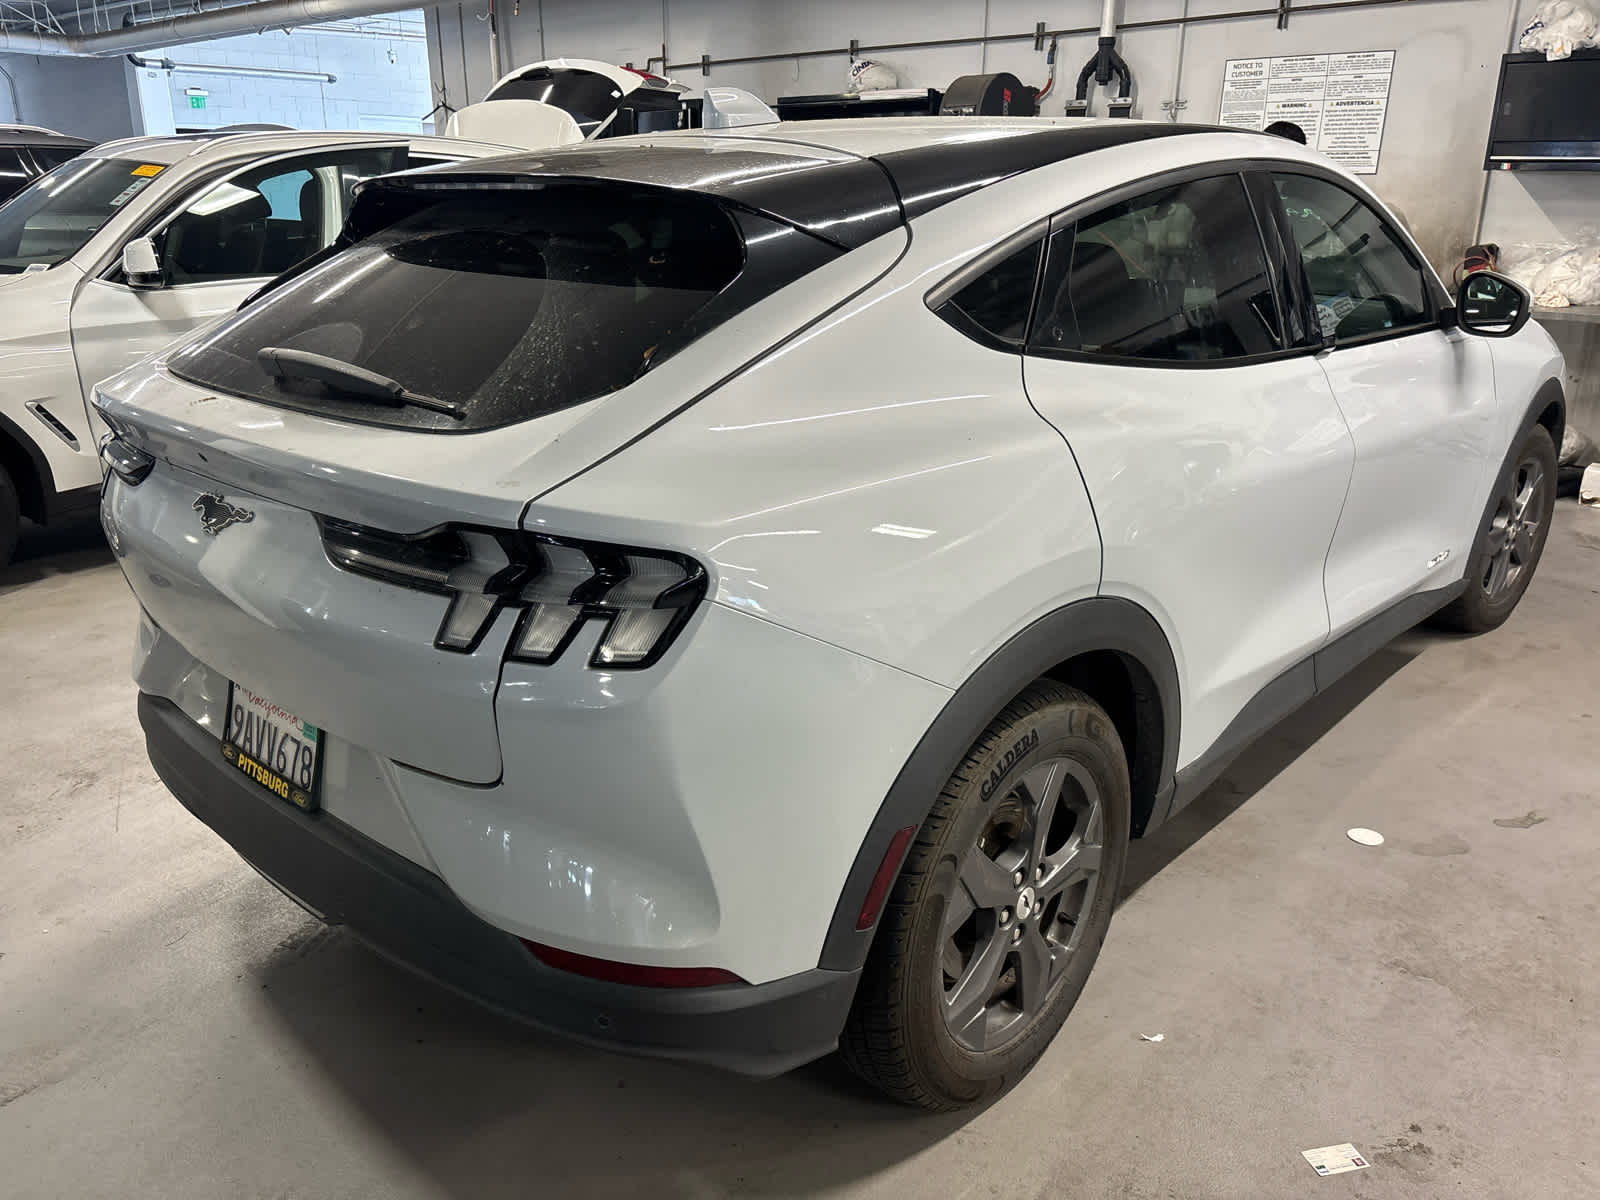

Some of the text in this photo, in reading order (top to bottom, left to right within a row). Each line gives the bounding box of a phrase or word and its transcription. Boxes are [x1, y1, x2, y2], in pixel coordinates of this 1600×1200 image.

[1231, 70, 1263, 78] CUSTOMER
[237, 753, 289, 798] PITTSBURG
[981, 727, 1040, 798] CALDERA
